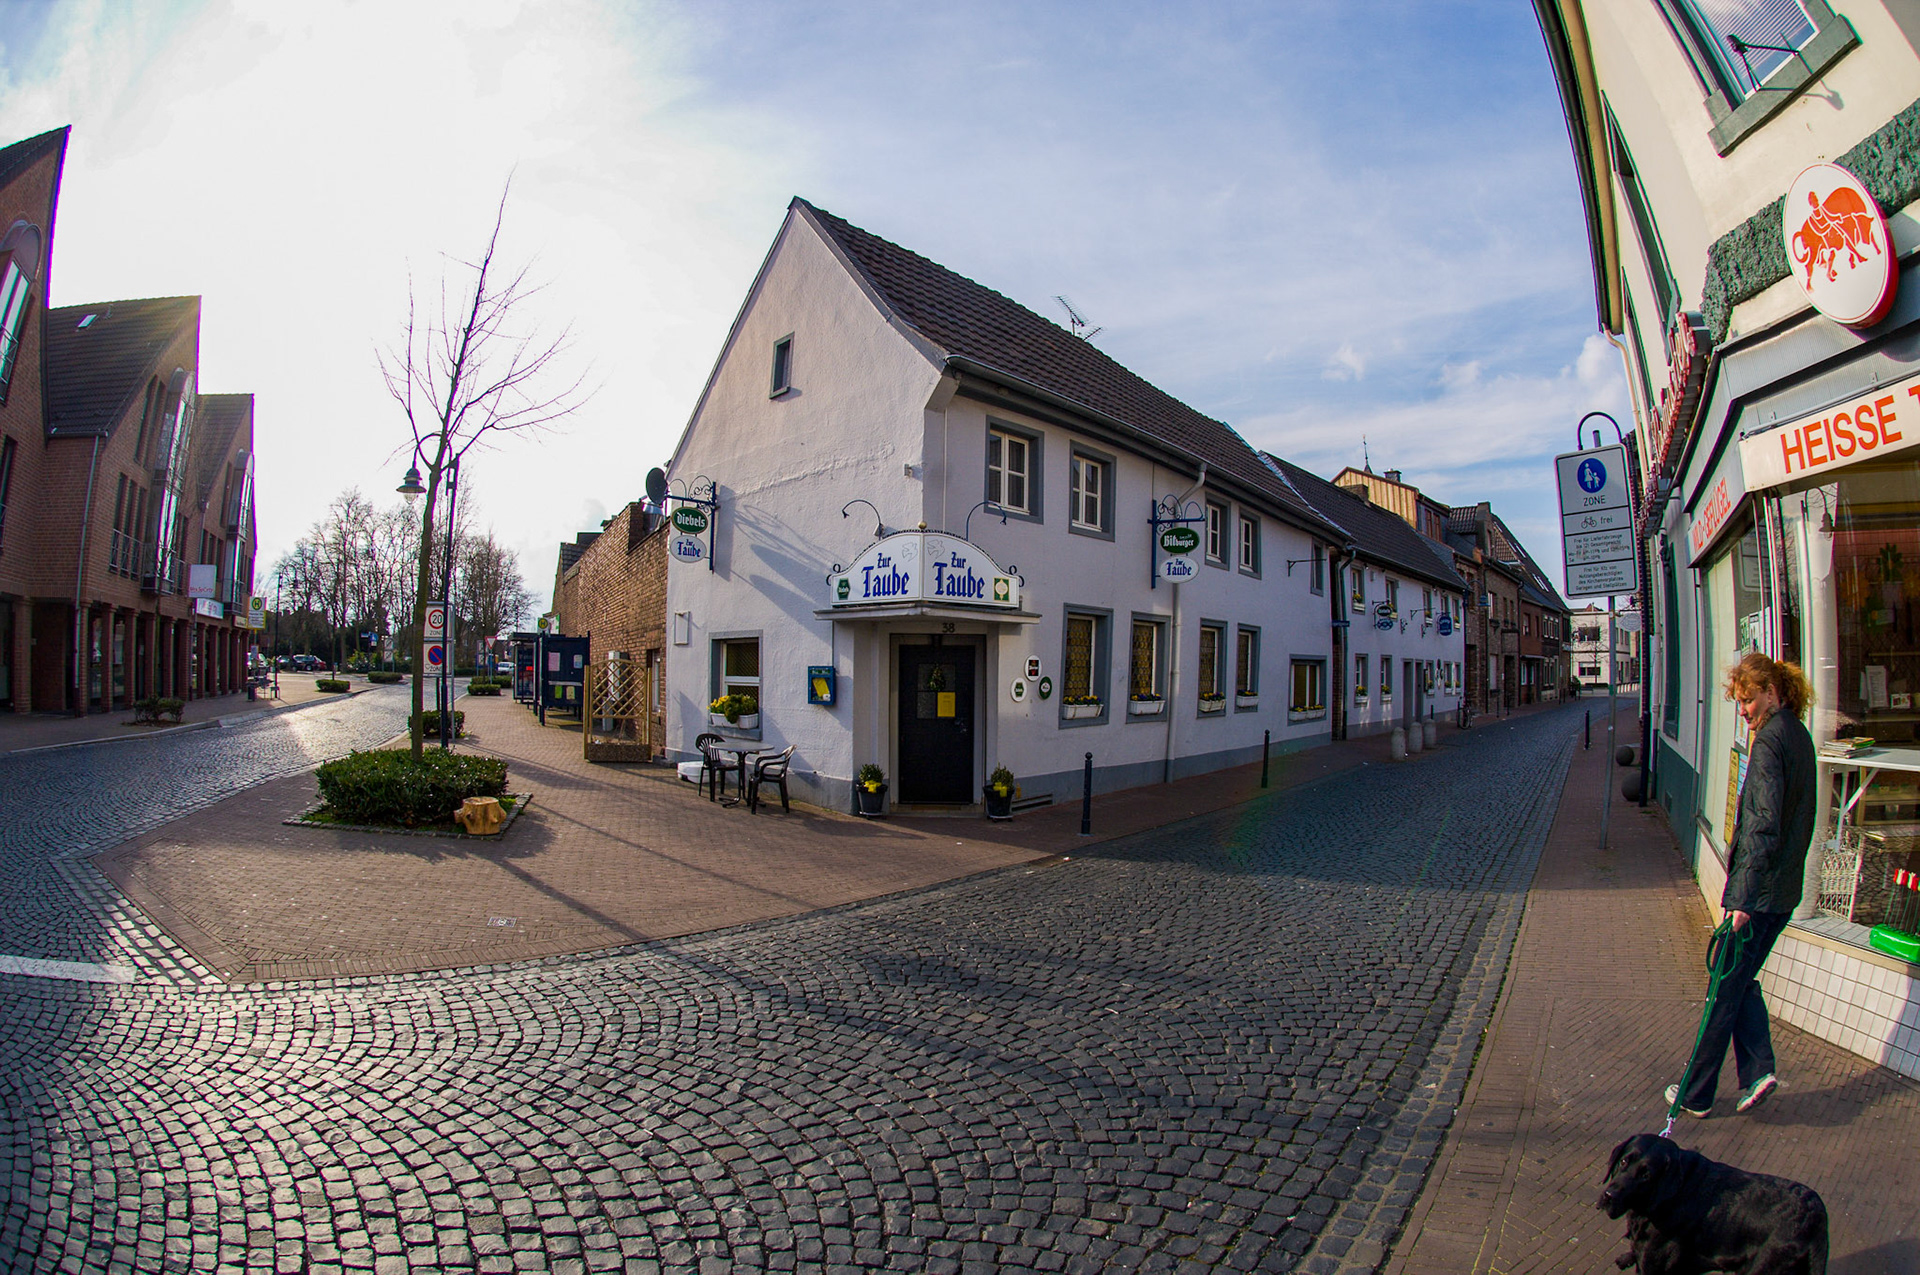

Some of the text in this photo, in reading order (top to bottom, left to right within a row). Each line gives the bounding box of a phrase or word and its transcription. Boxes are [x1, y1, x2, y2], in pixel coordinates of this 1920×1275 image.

[1780, 394, 1903, 475] HEISSE
[1583, 495, 1606, 507] ZONE
[676, 511, 706, 528] Diebels
[1600, 516, 1613, 524] frei
[677, 541, 702, 557] Taube
[1163, 534, 1194, 548] Bitburger
[877, 553, 892, 569] Zur
[951, 552, 967, 568] Zur
[1166, 562, 1192, 576] Taube
[861, 564, 910, 598] Taube
[932, 562, 985, 599] Taube
[432, 614, 442, 624] 20
[942, 622, 955, 633] 38
